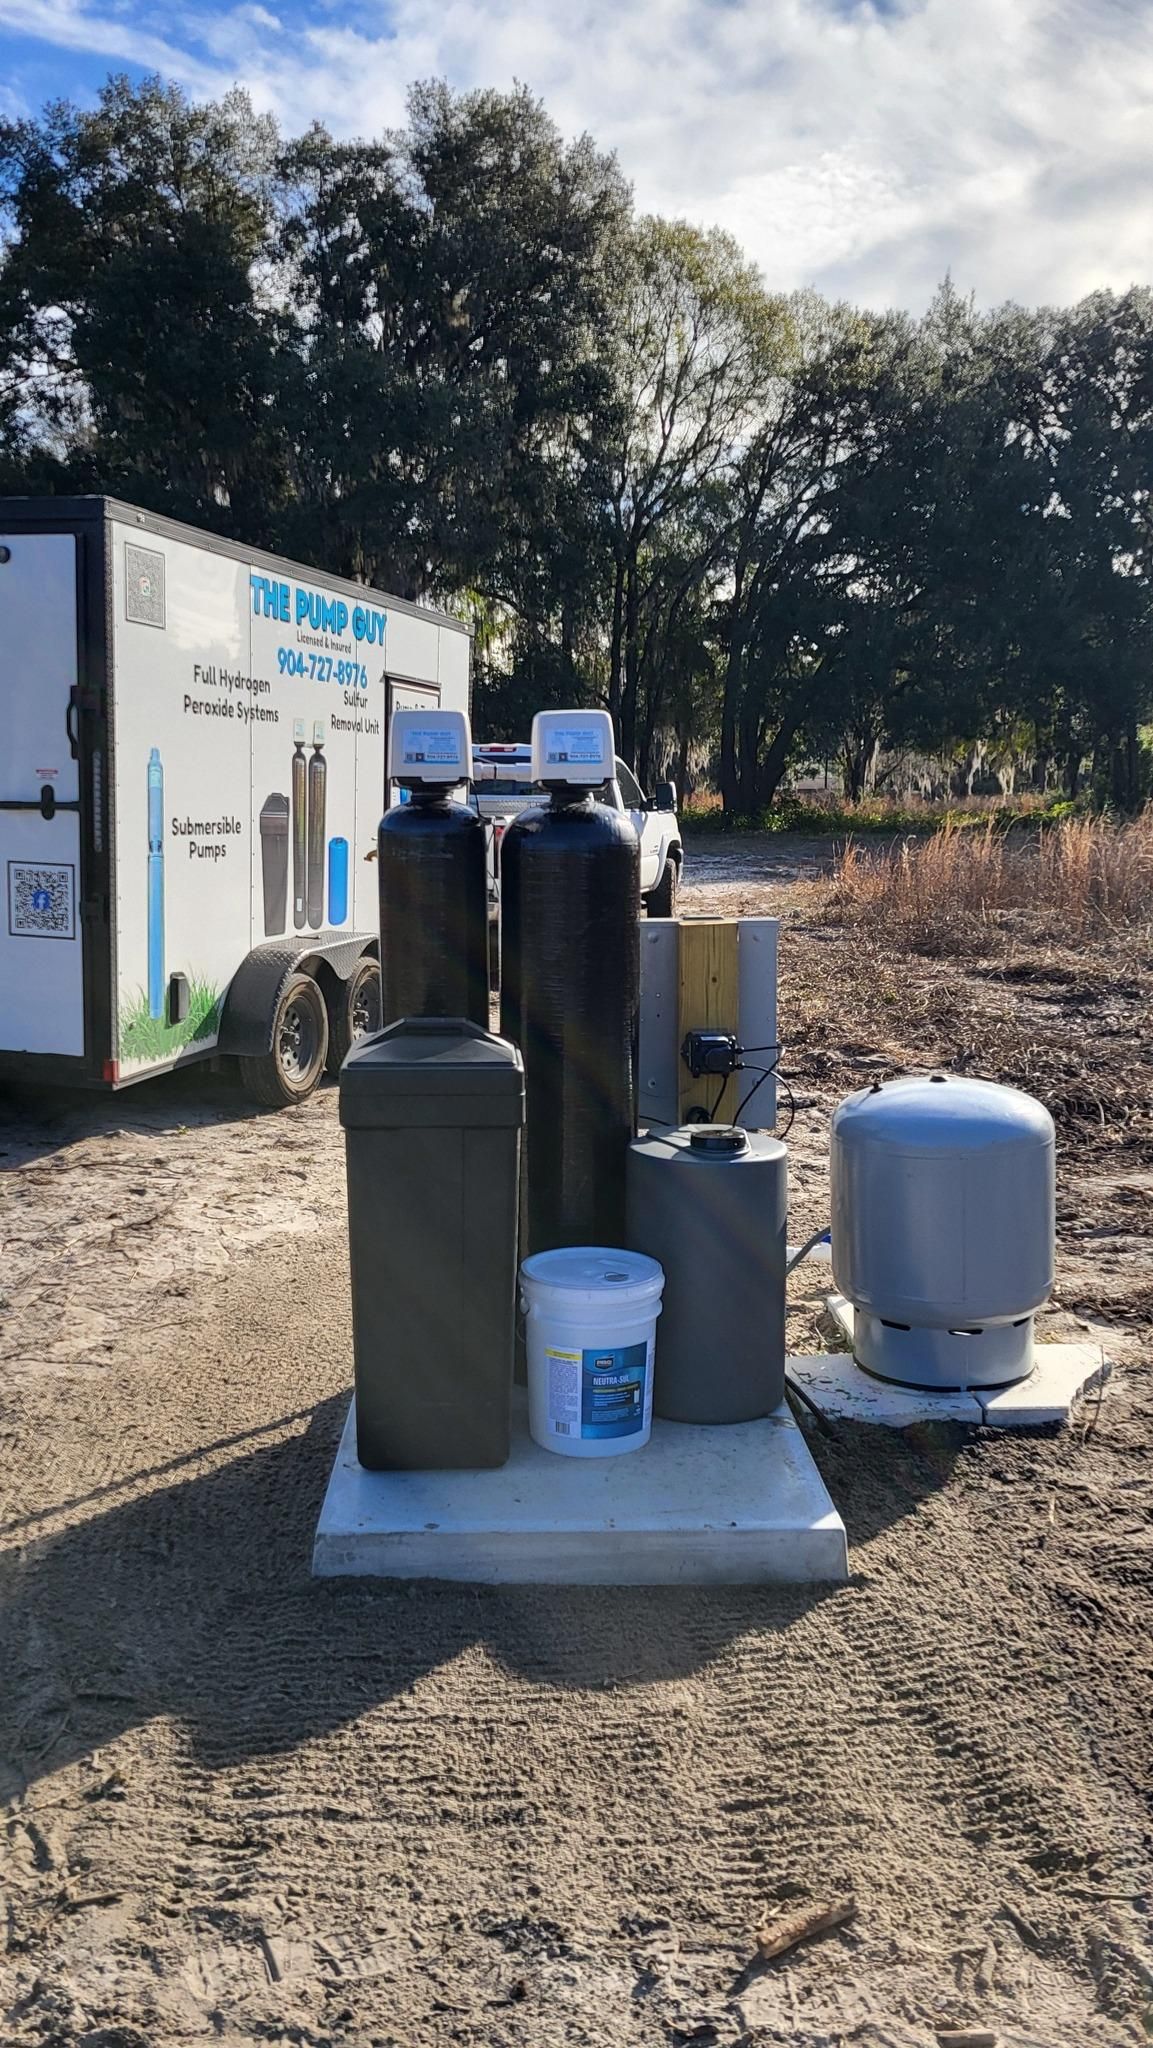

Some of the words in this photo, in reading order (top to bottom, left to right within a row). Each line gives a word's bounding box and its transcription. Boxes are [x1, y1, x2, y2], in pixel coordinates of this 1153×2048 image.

[249, 574, 291, 623] THE
[296, 588, 349, 636] PUMP
[352, 606, 387, 647] GUY
[296, 630, 323, 648] Licensed
[325, 637, 330, 649] &
[330, 638, 352, 654] Insured
[193, 665, 217, 686] Full
[219, 669, 271, 696] Hydrogen
[277, 647, 368, 690] 904-727-8976
[183, 694, 234, 718] Peroxide
[237, 700, 280, 725] Systems
[343, 690, 368, 708] Sulfur
[331, 713, 364, 732] Removal
[364, 719, 380, 735] Unit
[171, 815, 242, 836] Submersible
[189, 841, 227, 863] Pumps
